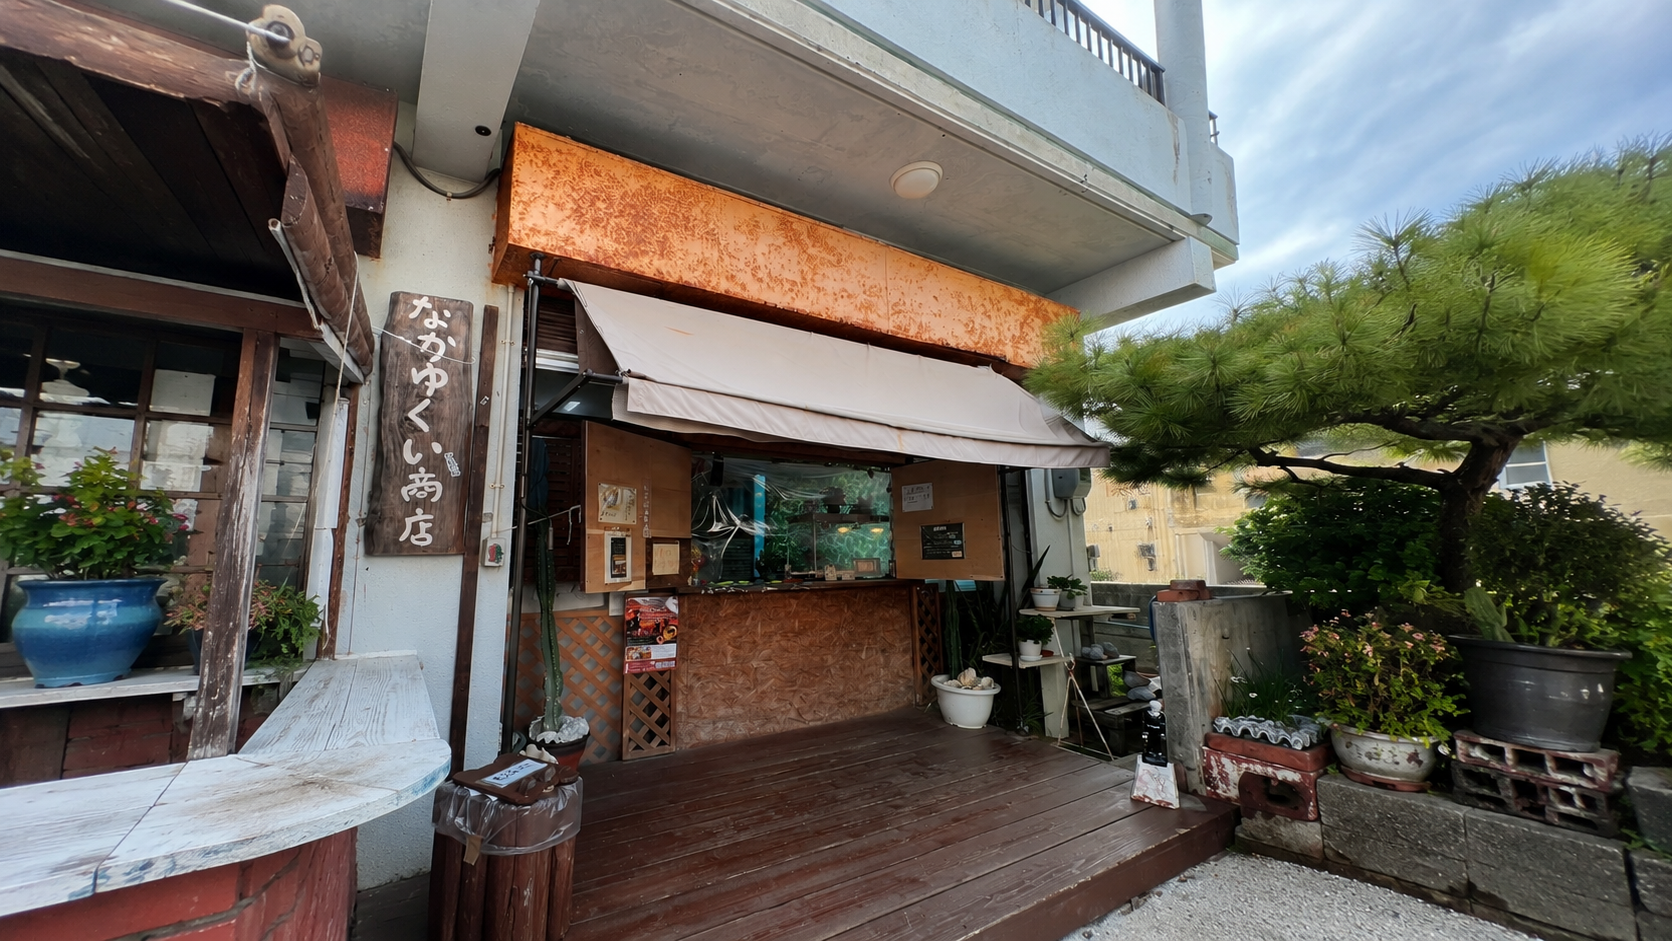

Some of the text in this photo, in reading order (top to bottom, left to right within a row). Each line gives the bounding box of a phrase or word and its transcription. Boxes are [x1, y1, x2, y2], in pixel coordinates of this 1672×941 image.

[399, 296, 457, 547] なかゆくい商店
